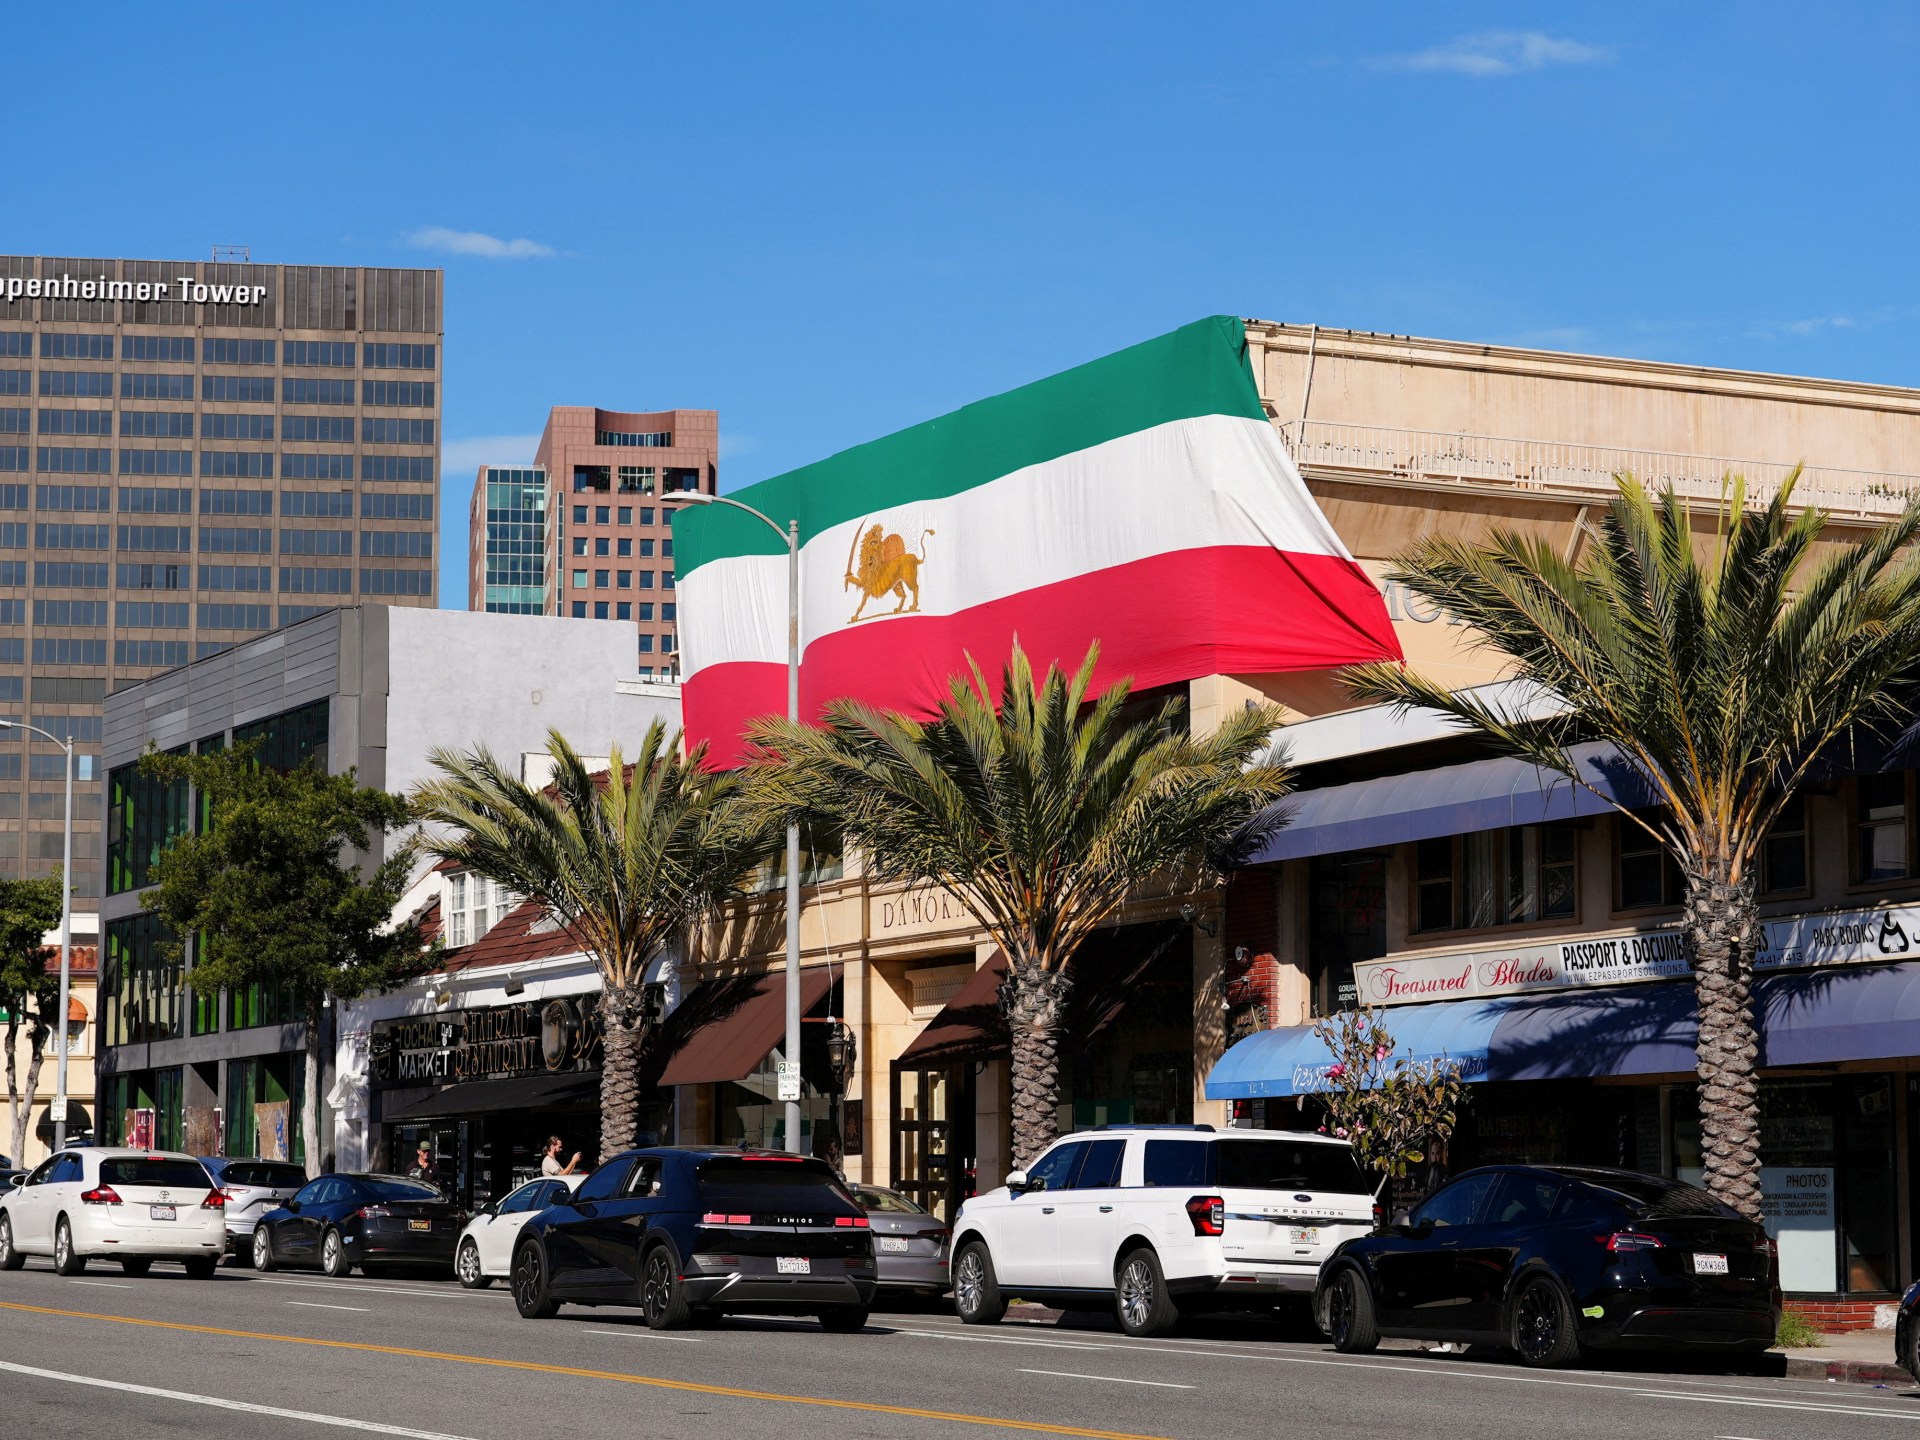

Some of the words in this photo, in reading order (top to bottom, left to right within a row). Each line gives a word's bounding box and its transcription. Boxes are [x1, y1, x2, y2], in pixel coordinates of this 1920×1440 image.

[0, 273, 168, 303] penheimer
[177, 278, 266, 305] Tower
[1813, 927, 1837, 948] PARS
[1839, 923, 1875, 945] BOOKS
[1563, 941, 1618, 971] PASSPORT
[1621, 941, 1631, 965] &
[1367, 965, 1472, 999] Treasured
[1477, 957, 1559, 987] Blades
[398, 1021, 441, 1049] TOCHAL
[462, 1007, 528, 1044] SHAHRZAD
[398, 1050, 450, 1080] MARKET
[454, 1039, 535, 1076] RESTAURANT
[779, 1063, 786, 1073] 2
[1786, 1174, 1827, 1188] PHOTOS
[1263, 1207, 1344, 1216] EXPEDITION
[1784, 1209, 1811, 1217] DOCUMENT
